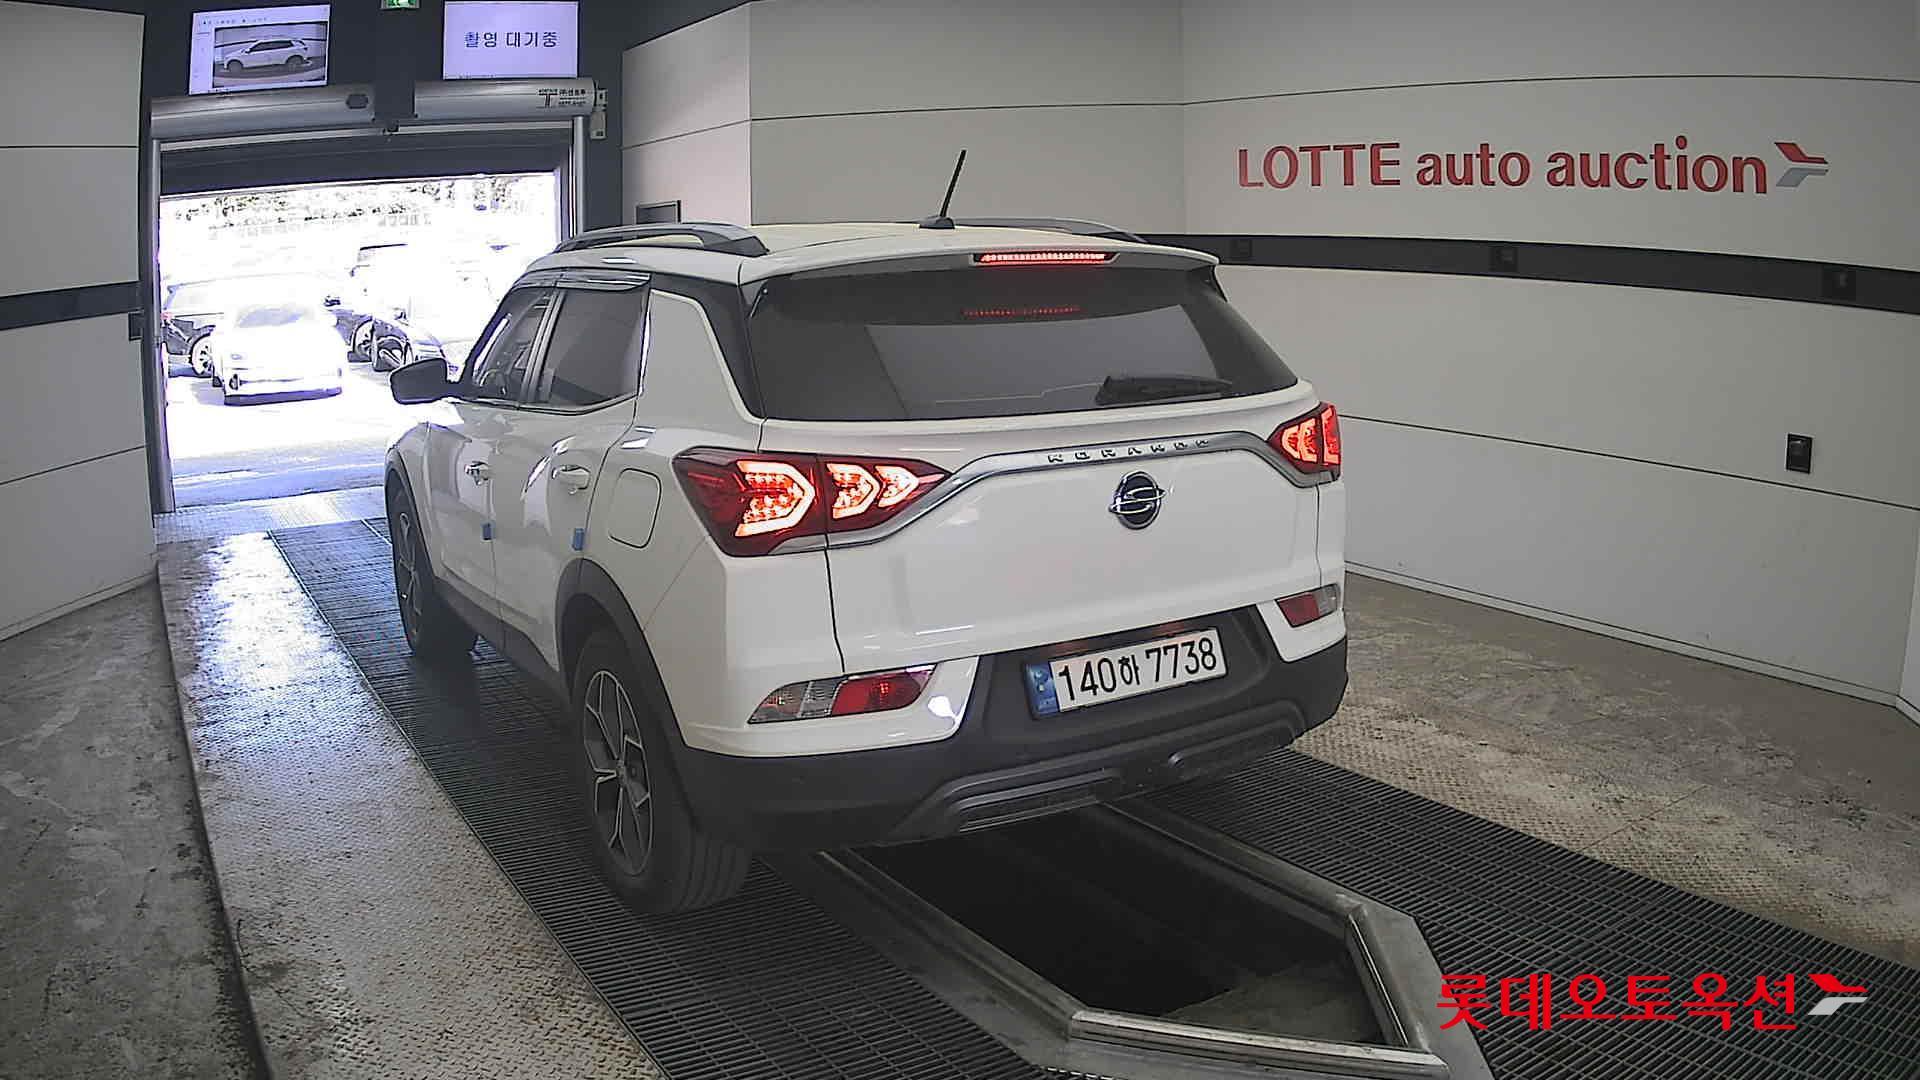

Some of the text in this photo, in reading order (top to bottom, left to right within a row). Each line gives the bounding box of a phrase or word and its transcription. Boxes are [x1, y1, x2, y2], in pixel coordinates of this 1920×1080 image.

[505, 31, 558, 48] 대기중
[1238, 135, 1767, 194] LOTTE auto auction
[1058, 637, 1217, 701] 140하 7738
